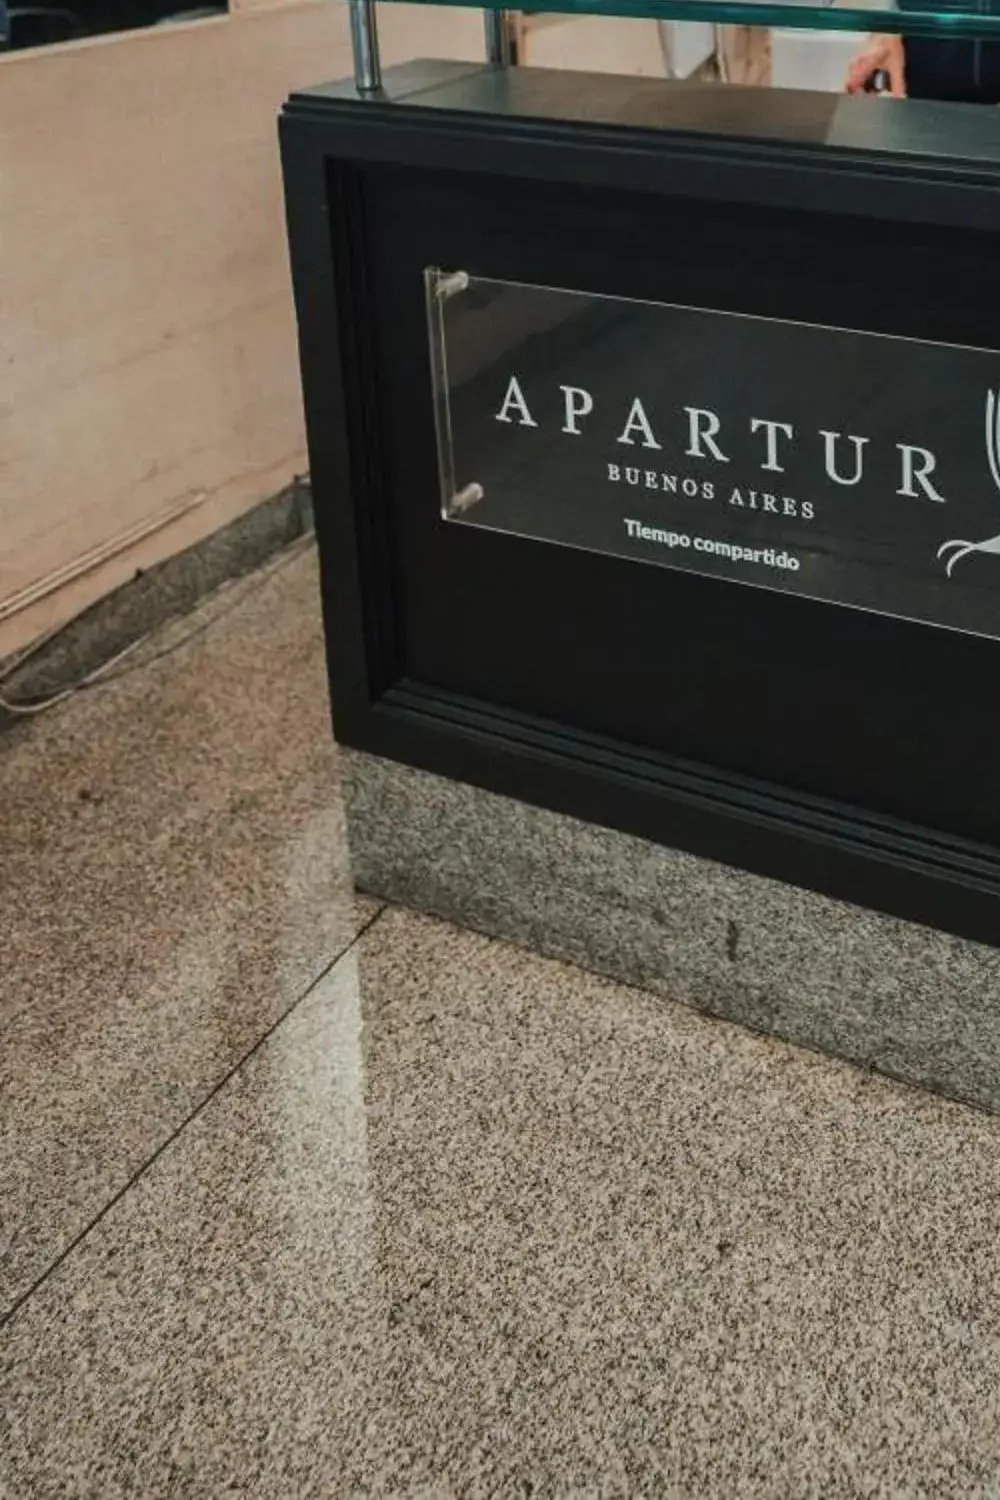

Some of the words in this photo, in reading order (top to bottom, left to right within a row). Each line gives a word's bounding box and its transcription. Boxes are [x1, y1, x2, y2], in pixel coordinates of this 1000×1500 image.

[495, 376, 946, 503] APARTUR
[607, 463, 715, 500] BUENOS
[728, 488, 815, 520] AIRES
[624, 517, 691, 548] Tiempo
[693, 536, 801, 571] compartido
